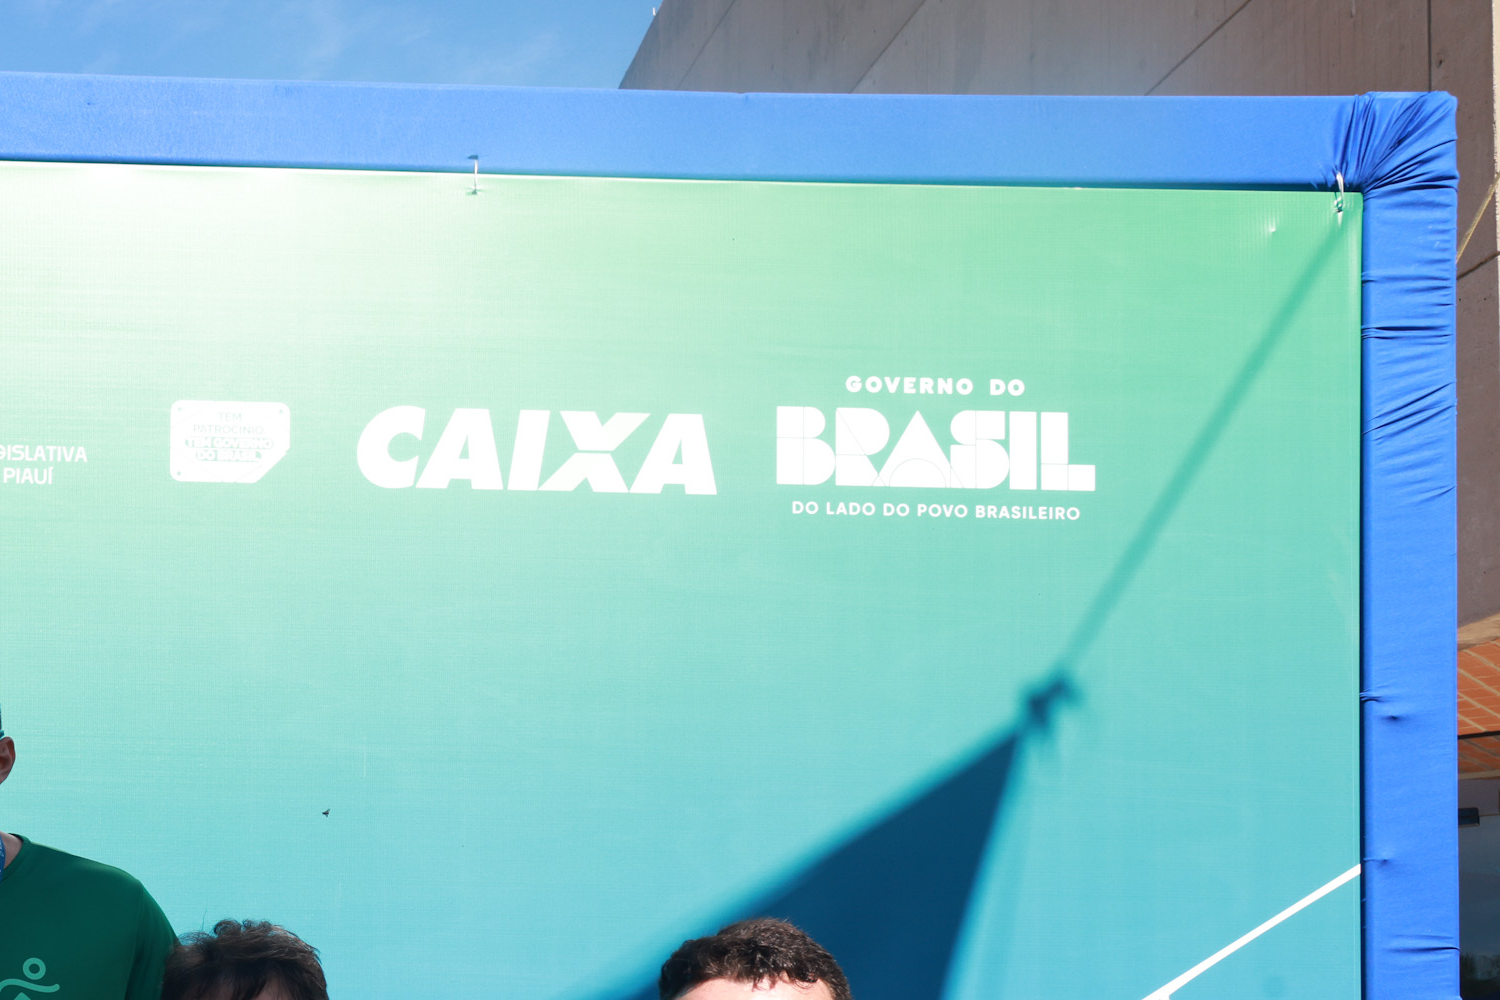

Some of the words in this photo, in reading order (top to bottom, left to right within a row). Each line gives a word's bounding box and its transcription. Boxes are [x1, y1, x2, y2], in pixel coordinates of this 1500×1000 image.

[845, 376, 973, 395] GOVERNO
[990, 378, 1025, 396] DO
[218, 412, 242, 422] TEM
[356, 405, 717, 495] CAIXA
[776, 406, 1096, 491] BRASIL
[3, 465, 53, 485] PIAUÍ
[792, 500, 819, 515] DO
[826, 502, 876, 516] LADO
[882, 503, 910, 517] DO
[916, 504, 968, 518] POVO
[974, 505, 1080, 521] BRASILEIRO
